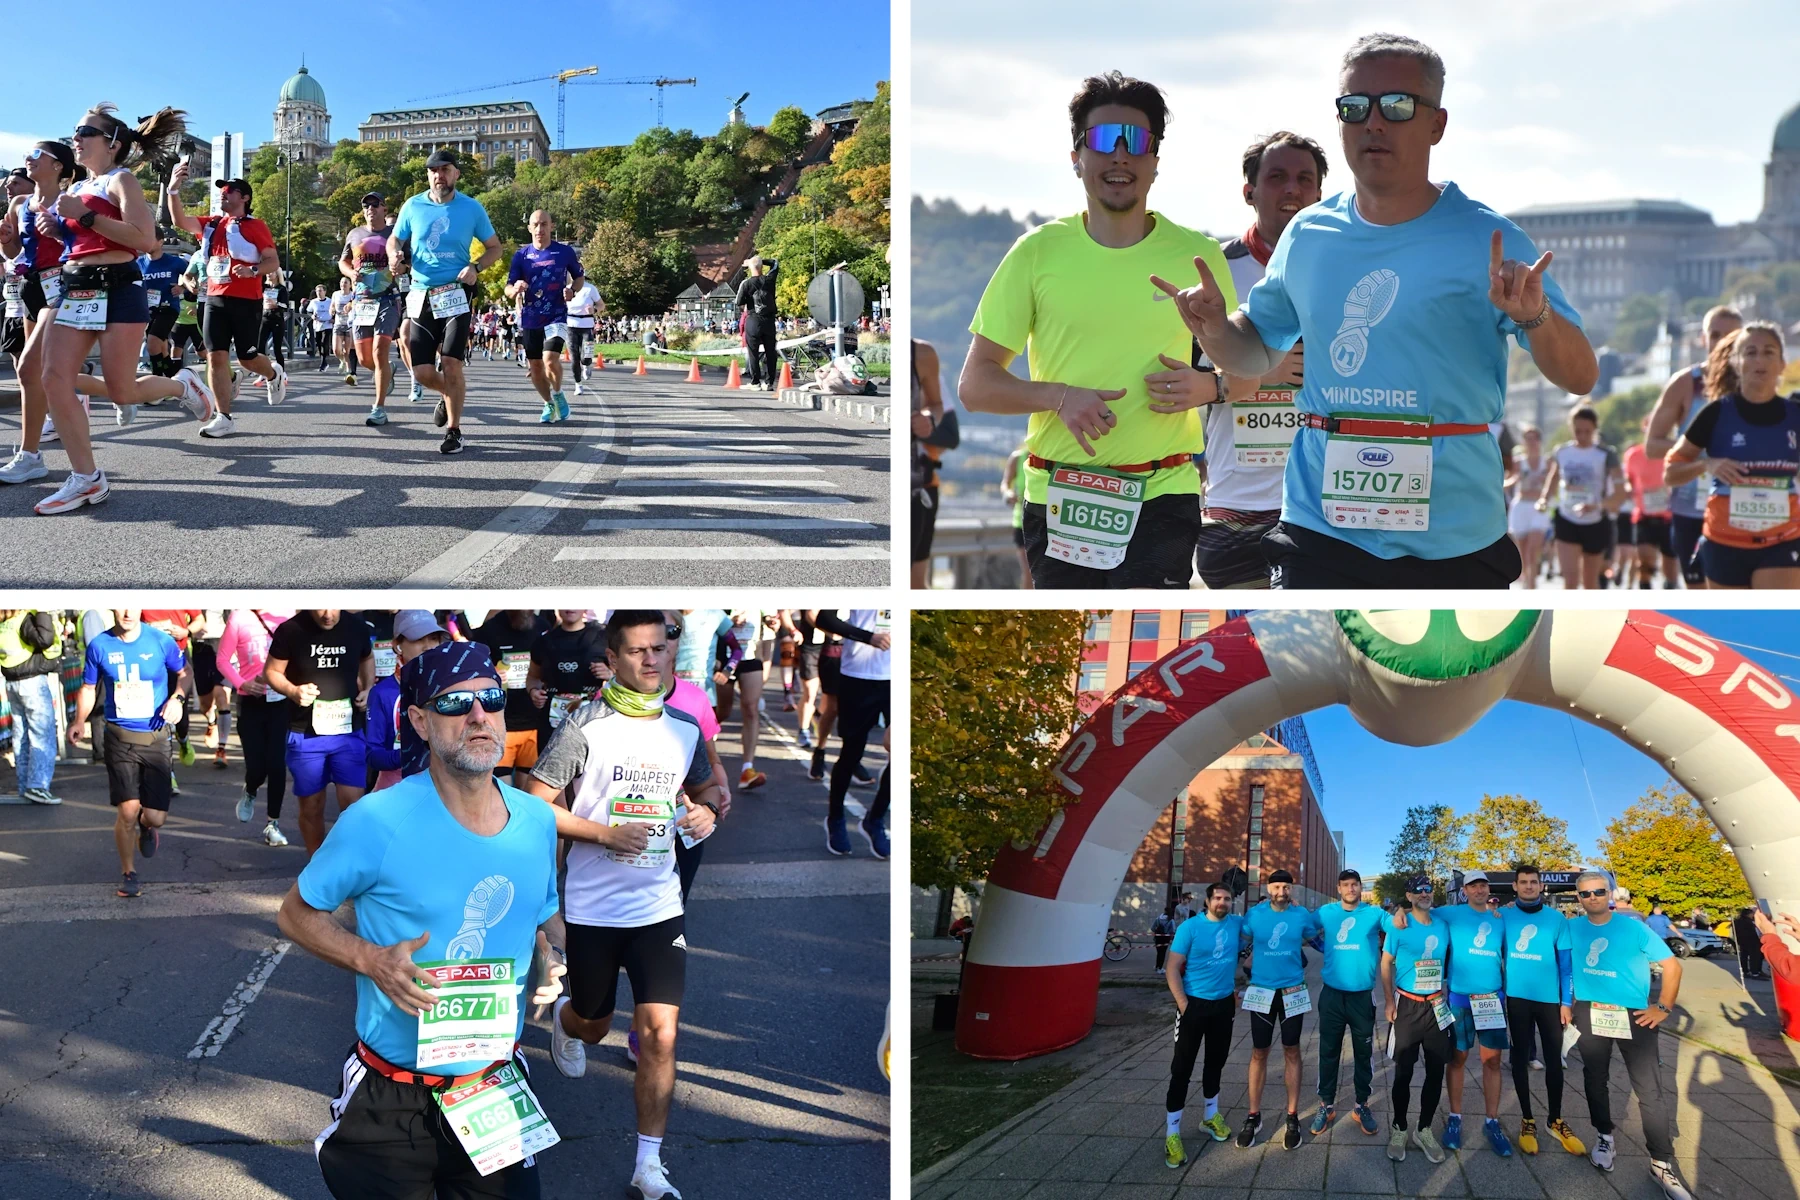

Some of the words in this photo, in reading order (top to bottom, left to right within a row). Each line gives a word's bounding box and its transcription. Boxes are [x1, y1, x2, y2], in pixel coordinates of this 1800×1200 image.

[76, 302, 99, 313] 2179
[440, 297, 462, 307] 15707
[1248, 392, 1291, 401] SPAR
[1247, 412, 1306, 429] 80438
[1362, 452, 1389, 462] TOLLE
[1067, 472, 1120, 491] SPAR
[1332, 470, 1404, 493] 15707
[1411, 478, 1421, 490] 3
[1735, 501, 1776, 514] 15355
[1051, 504, 1058, 515] 3
[1067, 504, 1128, 532] 16159
[310, 644, 347, 657] Jézus
[317, 657, 340, 668] ÉL!
[1655, 623, 1800, 738] SP
[613, 765, 676, 785] BUDAPEST
[630, 784, 671, 795] MARATON
[624, 804, 660, 815] SPAR
[1510, 952, 1542, 961] MINDSPIRE
[435, 967, 490, 980] SPAR
[429, 997, 493, 1021] 16677
[500, 998, 507, 1012] 1
[1595, 1018, 1619, 1026] 15707
[452, 1076, 499, 1101] SPAR
[461, 1125, 470, 1136] 3
[472, 1094, 528, 1133] 16677
